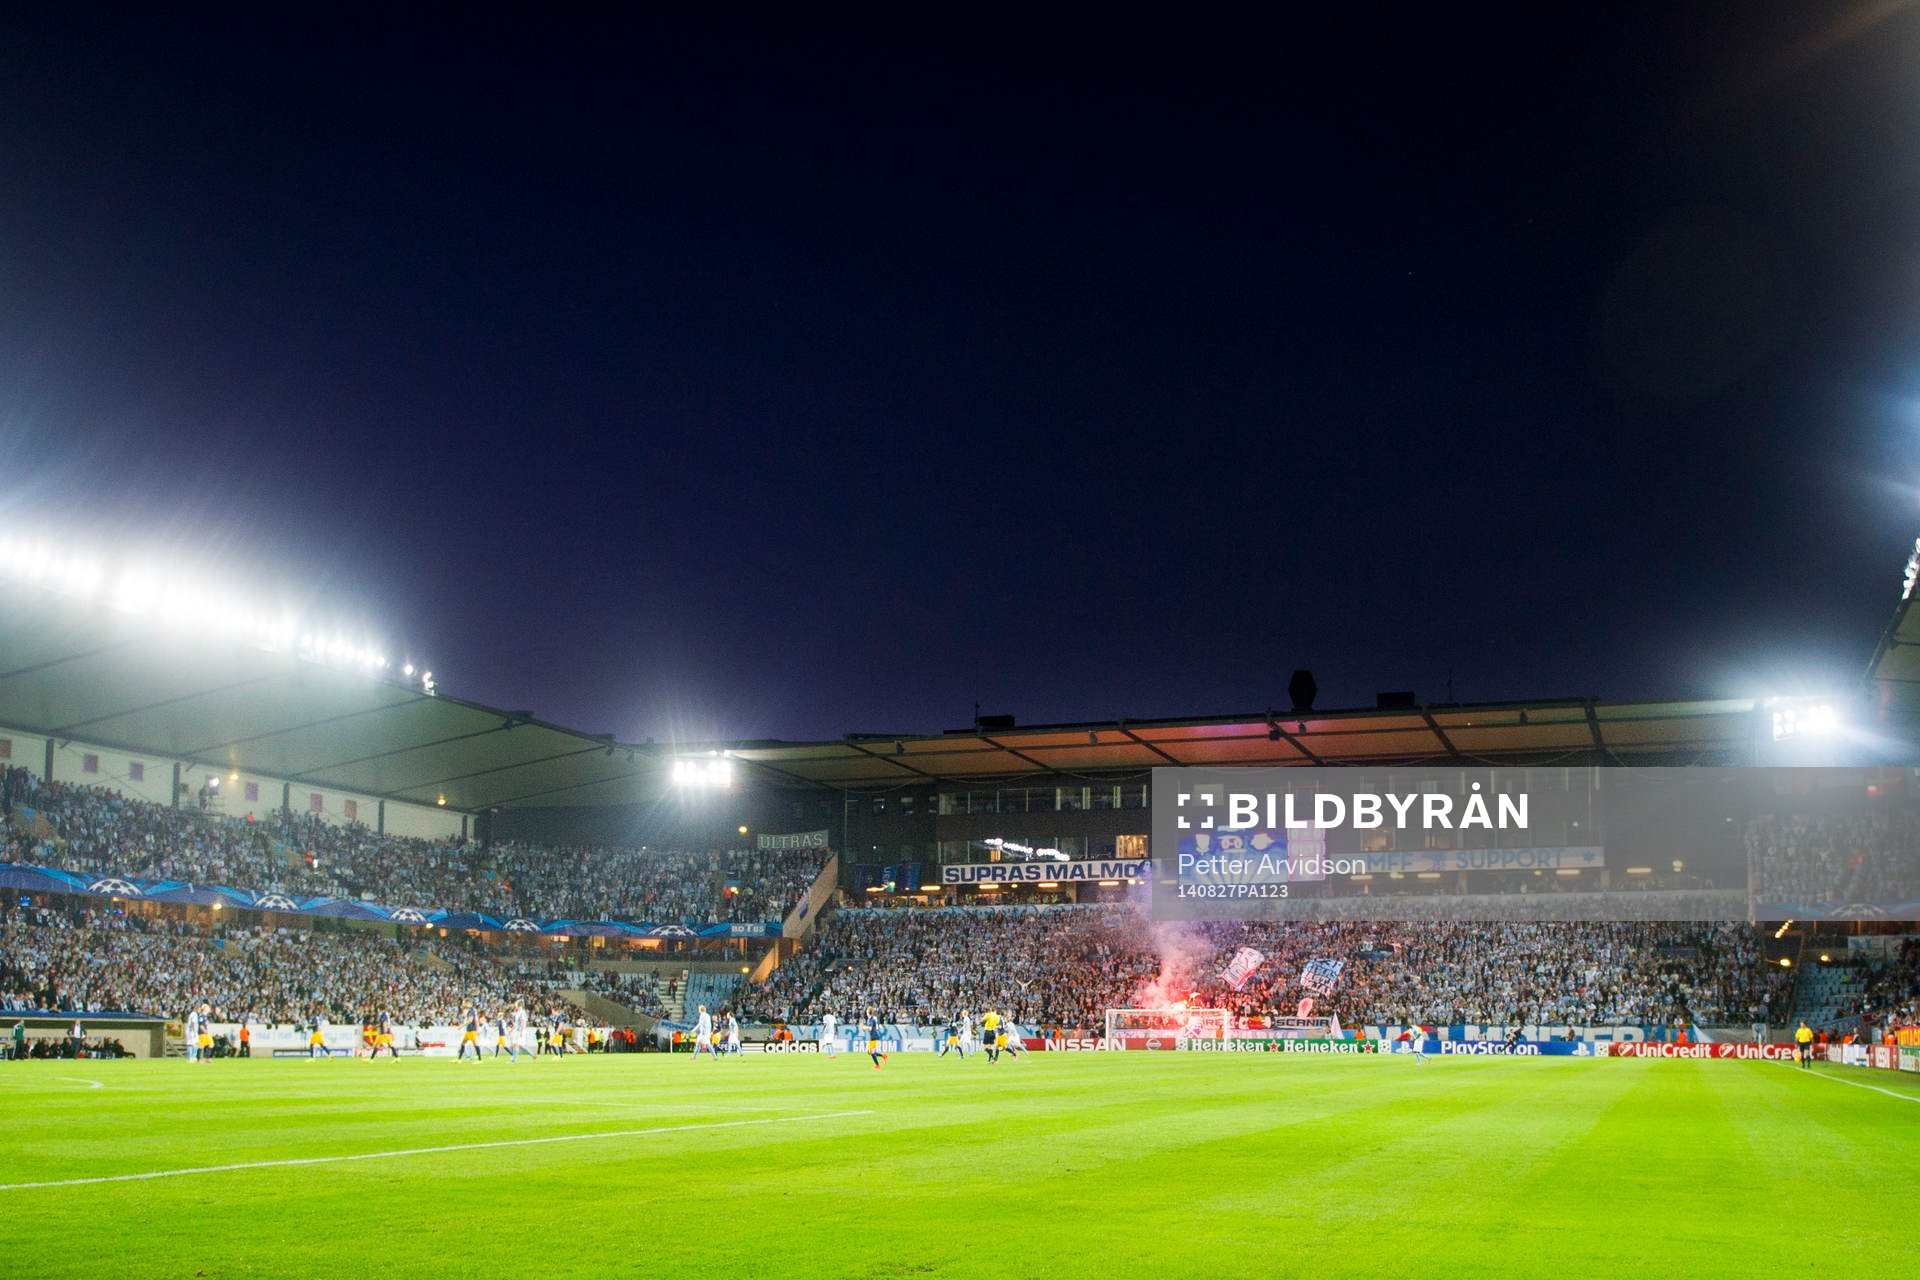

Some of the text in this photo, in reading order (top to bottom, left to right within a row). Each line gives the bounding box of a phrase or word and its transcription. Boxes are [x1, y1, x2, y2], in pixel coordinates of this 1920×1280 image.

[760, 833, 823, 849] ULTRAS
[1367, 848, 1565, 871] MFF SUPPORT
[945, 865, 1041, 882] SUPRAS
[1276, 1018, 1330, 1028] SCANIA
[765, 1040, 818, 1053] adidas
[1045, 1038, 1127, 1052] NISSAN
[1191, 1039, 1359, 1054] Heineken Heineken
[1636, 1043, 1712, 1059] UniCredit
